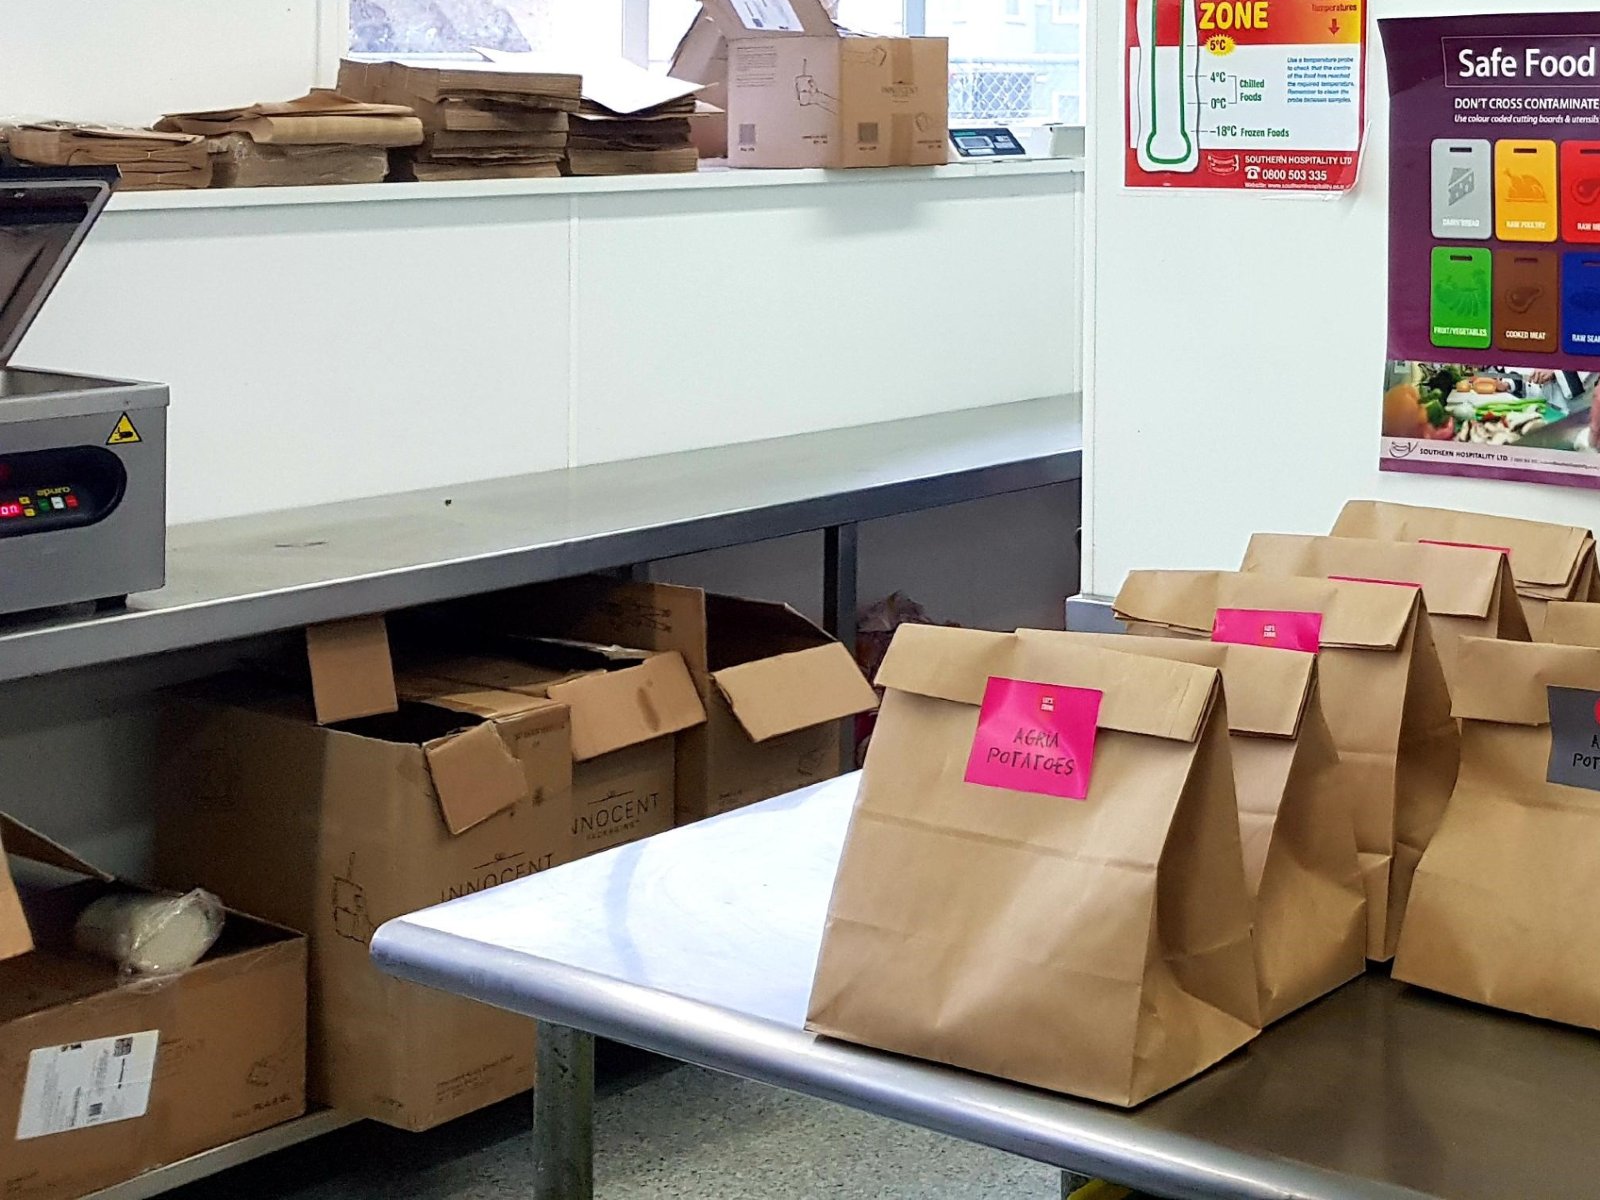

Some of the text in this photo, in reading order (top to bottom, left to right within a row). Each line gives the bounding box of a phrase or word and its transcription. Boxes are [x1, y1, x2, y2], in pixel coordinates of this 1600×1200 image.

[1199, 1, 1270, 30] ZONE
[1458, 46, 1596, 78] Safe Food
[1210, 71, 1226, 83] 4°C
[1239, 79, 1265, 88] Chilled
[1240, 92, 1262, 102] Foods
[1210, 97, 1227, 110] 0°C
[1454, 97, 1600, 110] DON'T CROSS CONTAMINATE
[1454, 113, 1600, 125] Use colour coded cutting boards & utensils
[1240, 127, 1290, 138] Frozen Foods
[1244, 154, 1352, 165] SOUTHERN HOSPITALITY LTD
[1262, 169, 1327, 181] 0800 503 335
[1576, 222, 1591, 231] RAW
[1433, 326, 1488, 338] FRUIT/VEGETABLES
[1505, 330, 1547, 340] COOKED MEAT
[1571, 333, 1586, 343] RAW
[1419, 447, 1454, 457] SOUTHERN
[1455, 451, 1496, 461] HOSPITALITY
[36, 486, 71, 497] apuro
[1012, 727, 1060, 749] AGRIA
[986, 747, 1075, 776] POTATOES
[571, 793, 659, 835] NNOCENT
